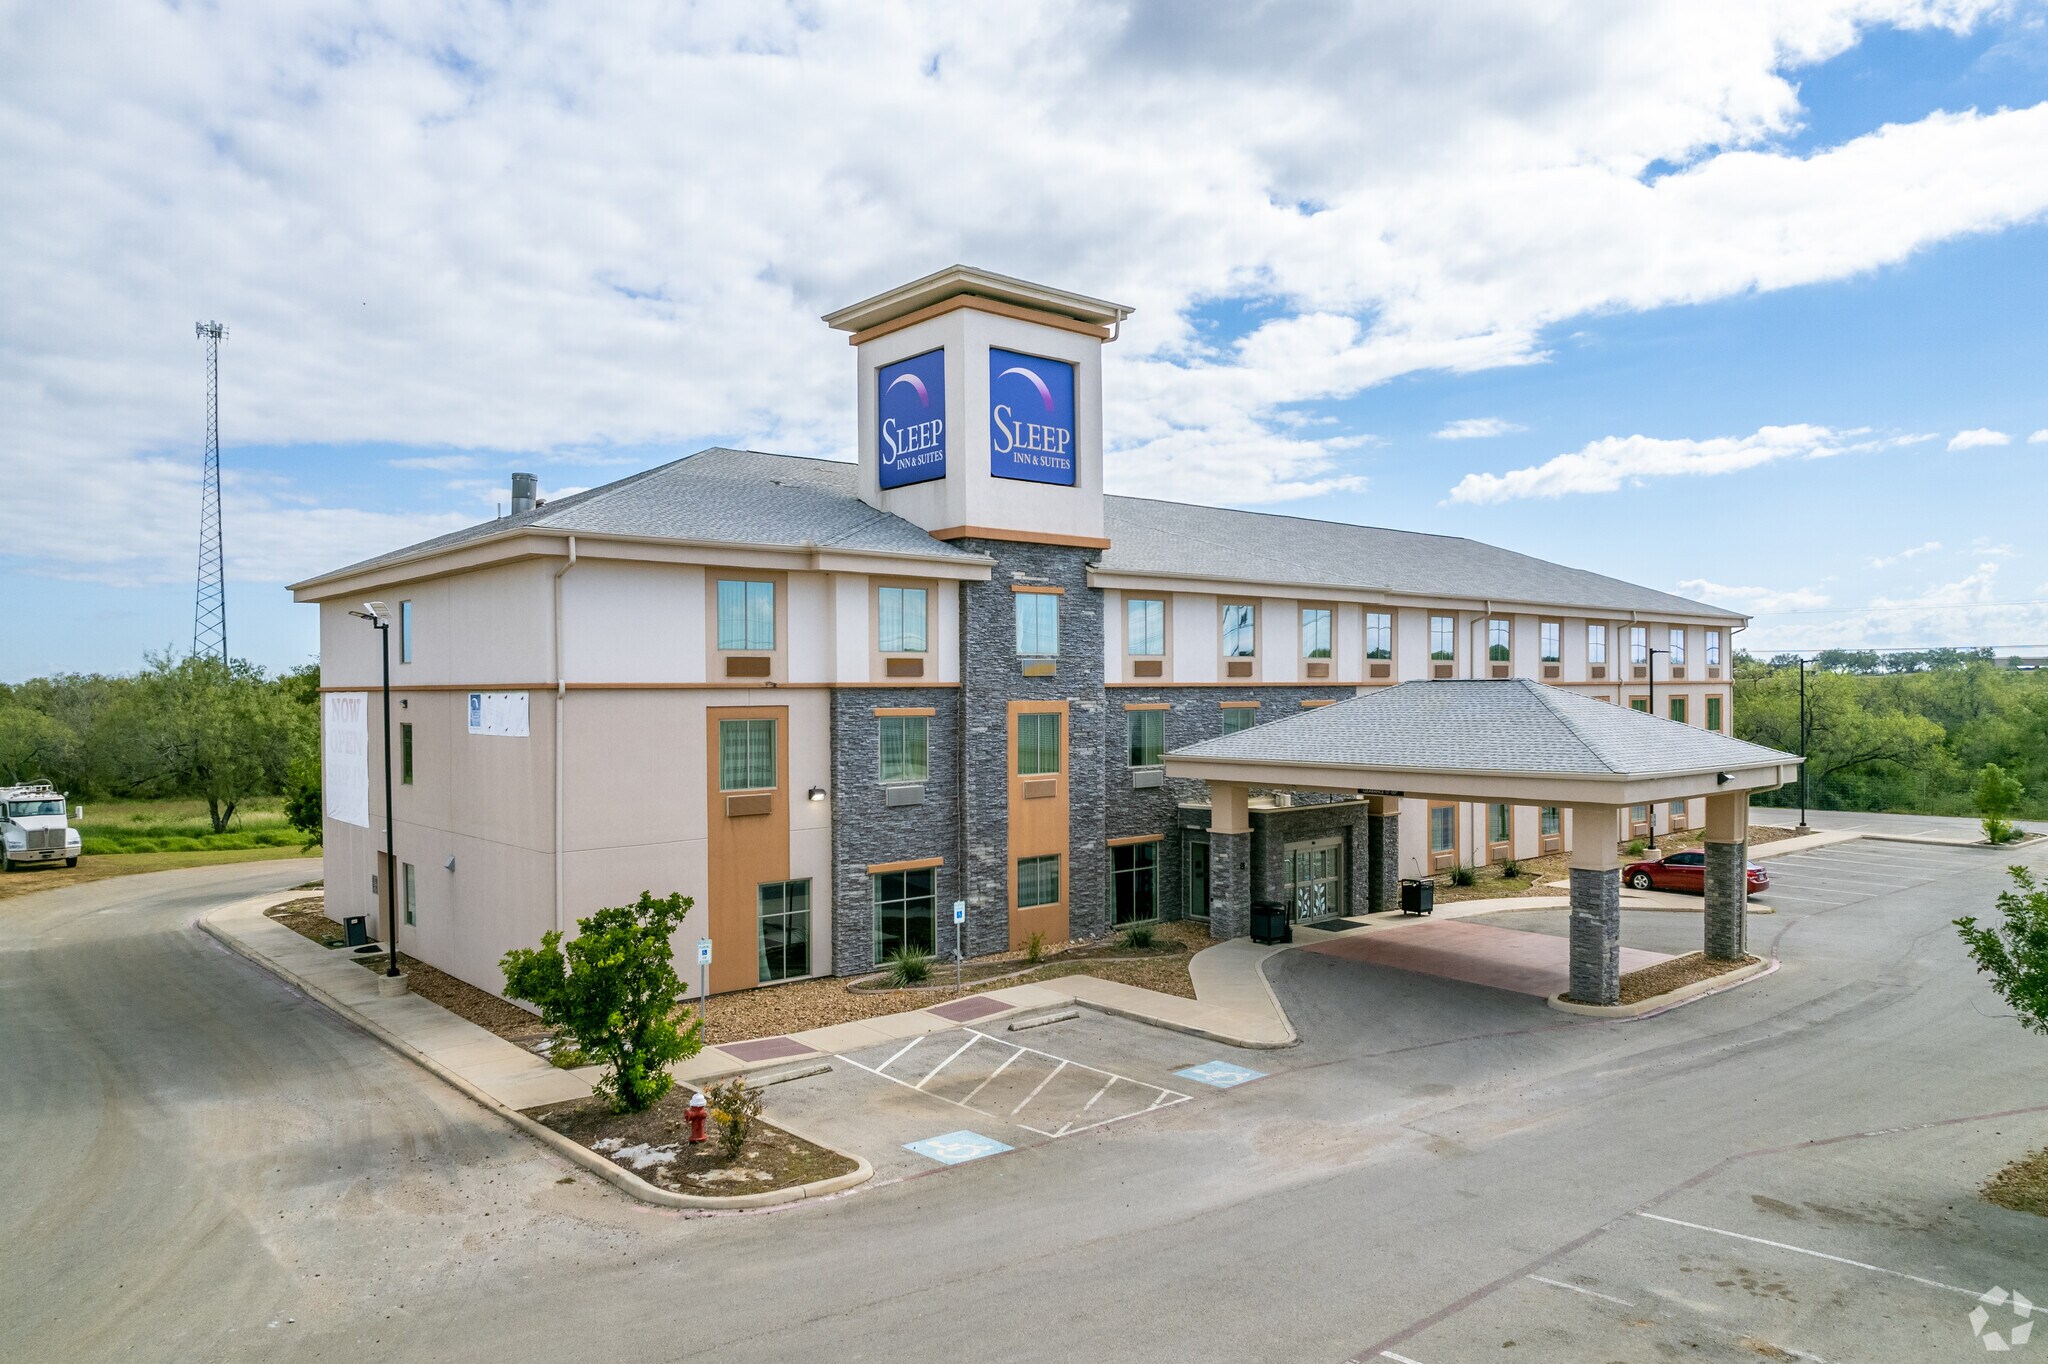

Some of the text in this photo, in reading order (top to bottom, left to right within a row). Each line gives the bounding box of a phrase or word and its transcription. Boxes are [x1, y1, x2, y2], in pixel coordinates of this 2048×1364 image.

[883, 418, 943, 465] SLEEP
[993, 404, 1070, 454] SLEEP
[897, 449, 943, 470] INN & SUITES
[1013, 451, 1071, 470] INN & SUITES
[331, 697, 362, 723] NOW
[329, 729, 363, 756] OPEN
